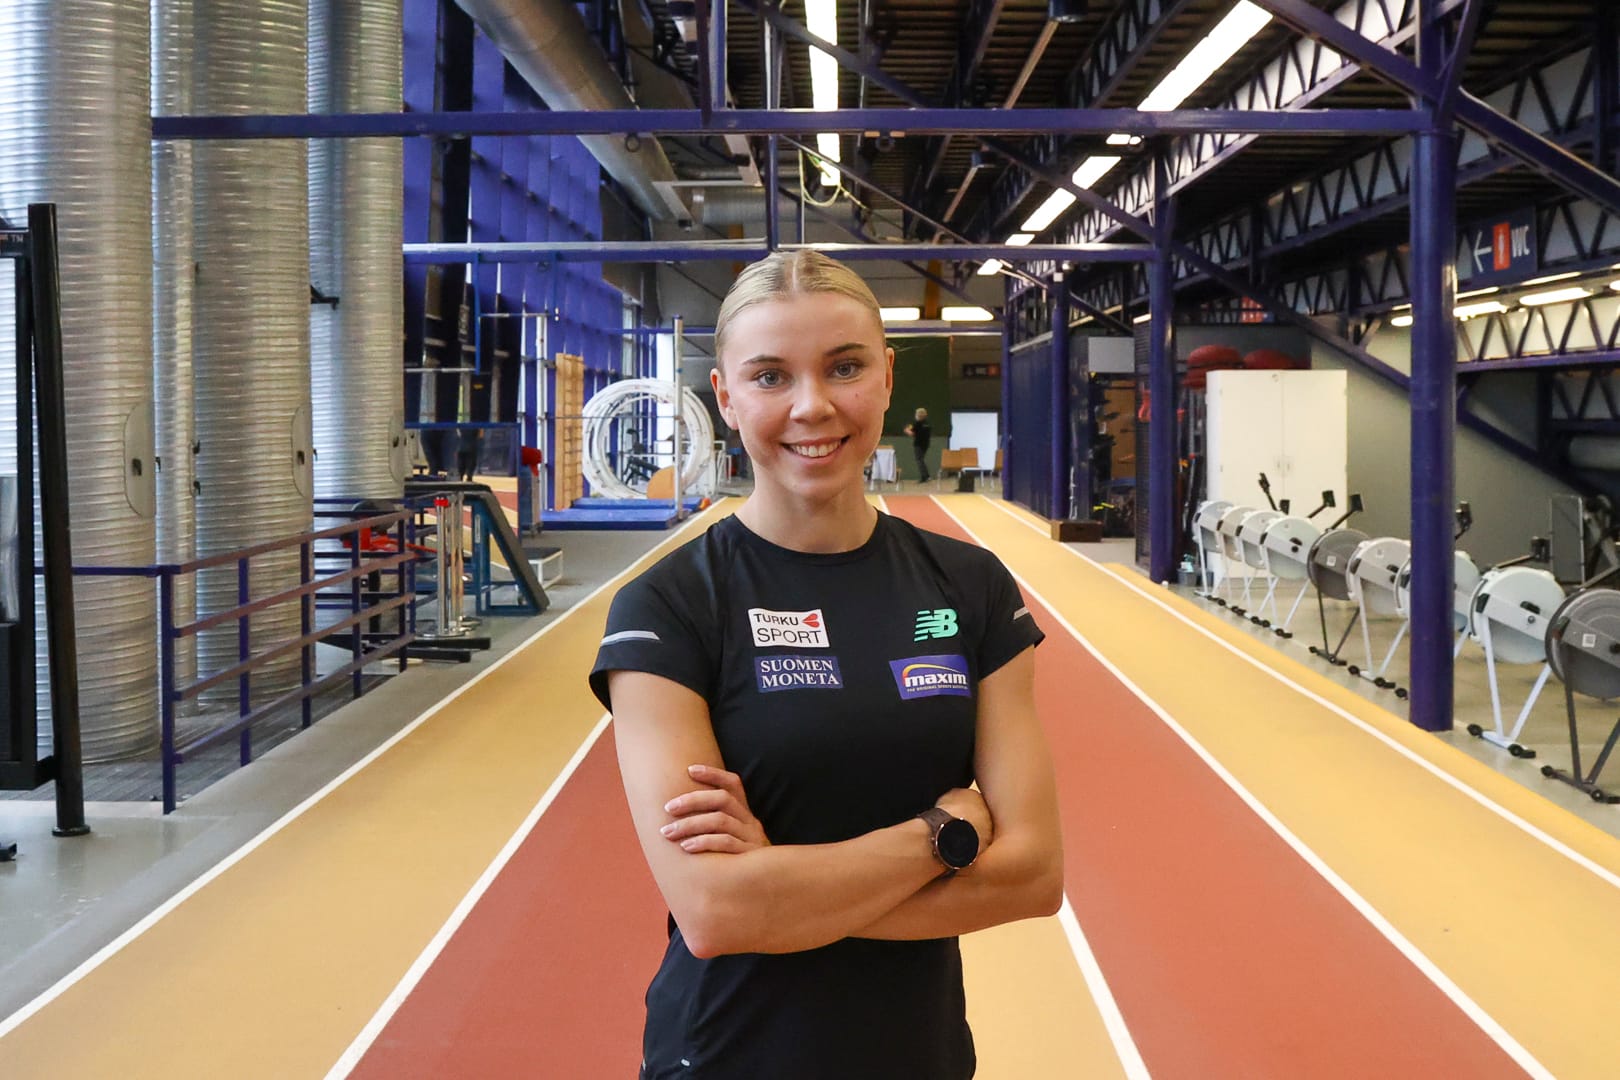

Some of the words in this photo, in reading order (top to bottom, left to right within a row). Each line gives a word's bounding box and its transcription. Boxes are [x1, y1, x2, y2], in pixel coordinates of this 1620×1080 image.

[1511, 225, 1530, 258] WC
[753, 613, 799, 626] TURKU
[756, 627, 822, 644] SPORT
[760, 659, 834, 673] SUOMEN
[762, 673, 840, 689] MONETA
[904, 673, 967, 688] maxim
